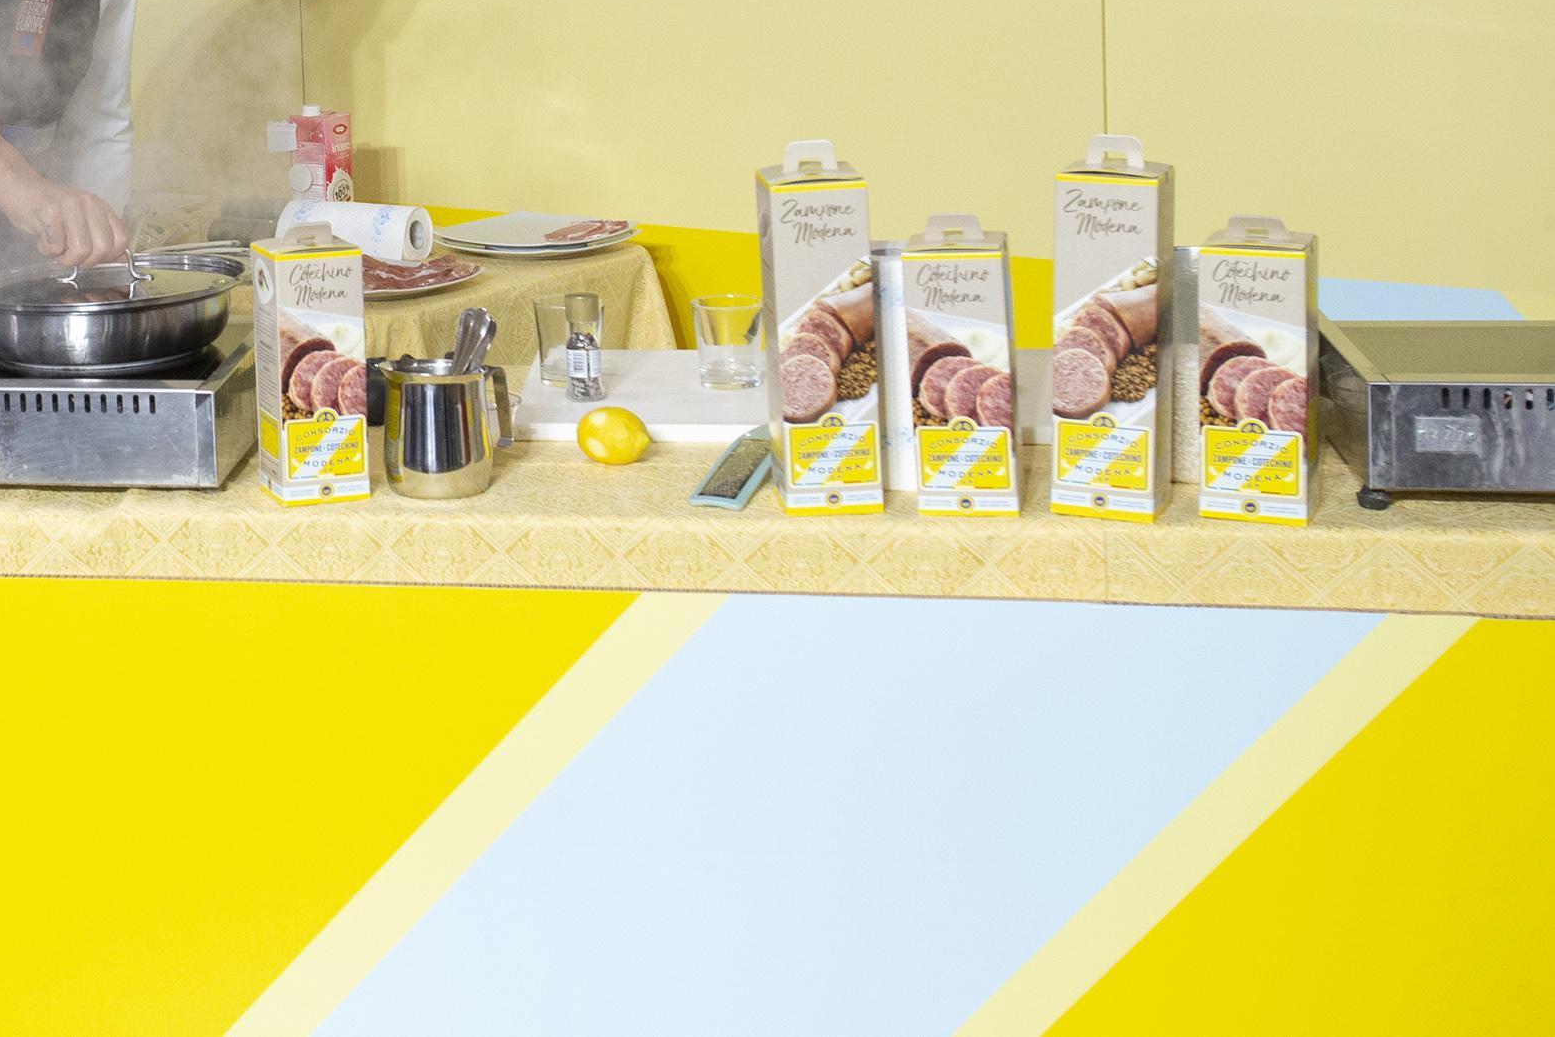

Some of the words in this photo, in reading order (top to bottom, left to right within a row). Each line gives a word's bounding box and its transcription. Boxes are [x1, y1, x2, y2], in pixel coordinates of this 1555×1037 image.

[780, 199, 856, 224] Zampone
[1063, 188, 1143, 214] Zampone
[792, 222, 857, 248] Modena
[1075, 212, 1143, 240] Modena
[289, 262, 353, 286] Cotechino
[1213, 259, 1291, 283] Cotechino
[294, 284, 349, 308] Modena
[923, 286, 986, 311] Modena
[1219, 282, 1286, 309] Modena
[296, 426, 355, 442] CONSORZIO
[1215, 439, 1289, 454] CONSORZIO
[302, 456, 351, 468] MODENA
[1223, 471, 1281, 482] MODENA
